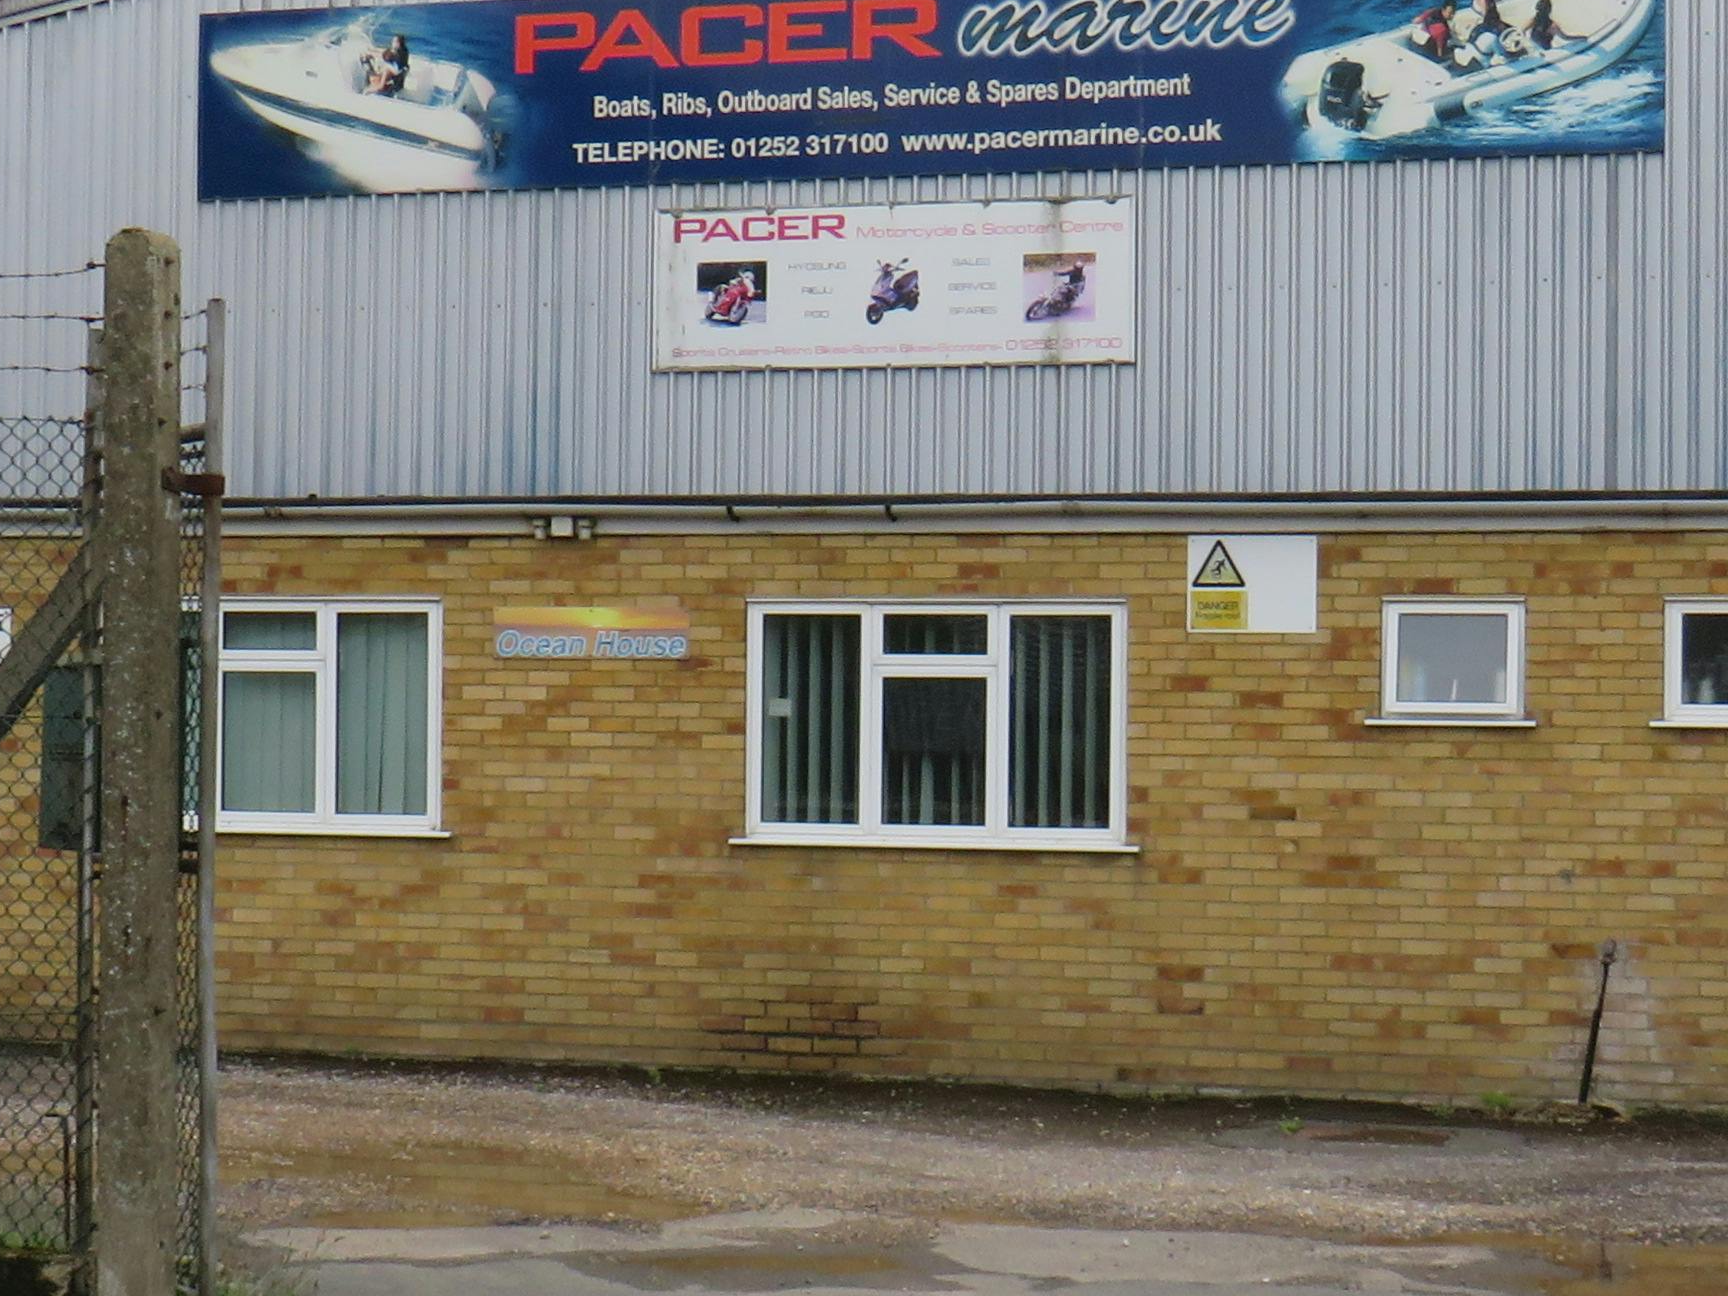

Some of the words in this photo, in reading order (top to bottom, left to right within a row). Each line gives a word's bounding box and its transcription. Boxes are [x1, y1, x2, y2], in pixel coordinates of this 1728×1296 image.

[593, 94, 657, 121] Boats,
[662, 91, 712, 117] Ribs,
[718, 87, 812, 114] Outboard
[816, 84, 878, 111] Sales,
[884, 81, 961, 108] Service
[966, 80, 982, 105] &
[986, 78, 1059, 108] Spares
[1065, 72, 1192, 104] Department
[572, 138, 726, 164] TELEPHONE:
[731, 135, 800, 159] 01252
[805, 132, 889, 156] 317100
[901, 118, 1222, 154] www.pacermarine.co.uk
[673, 214, 848, 244] PACER
[856, 223, 958, 240] Motorcycle
[962, 223, 977, 236] &
[982, 222, 1053, 236] Scooter
[1059, 220, 1124, 233] Centre
[952, 257, 991, 267] SALES
[947, 281, 998, 292] SERVICE
[949, 305, 999, 316] SPARES
[1005, 338, 1058, 351] 01252
[1063, 336, 1122, 350] 317100
[1198, 600, 1239, 610] DANGER
[496, 629, 587, 658] Ocean
[593, 630, 688, 658] House
